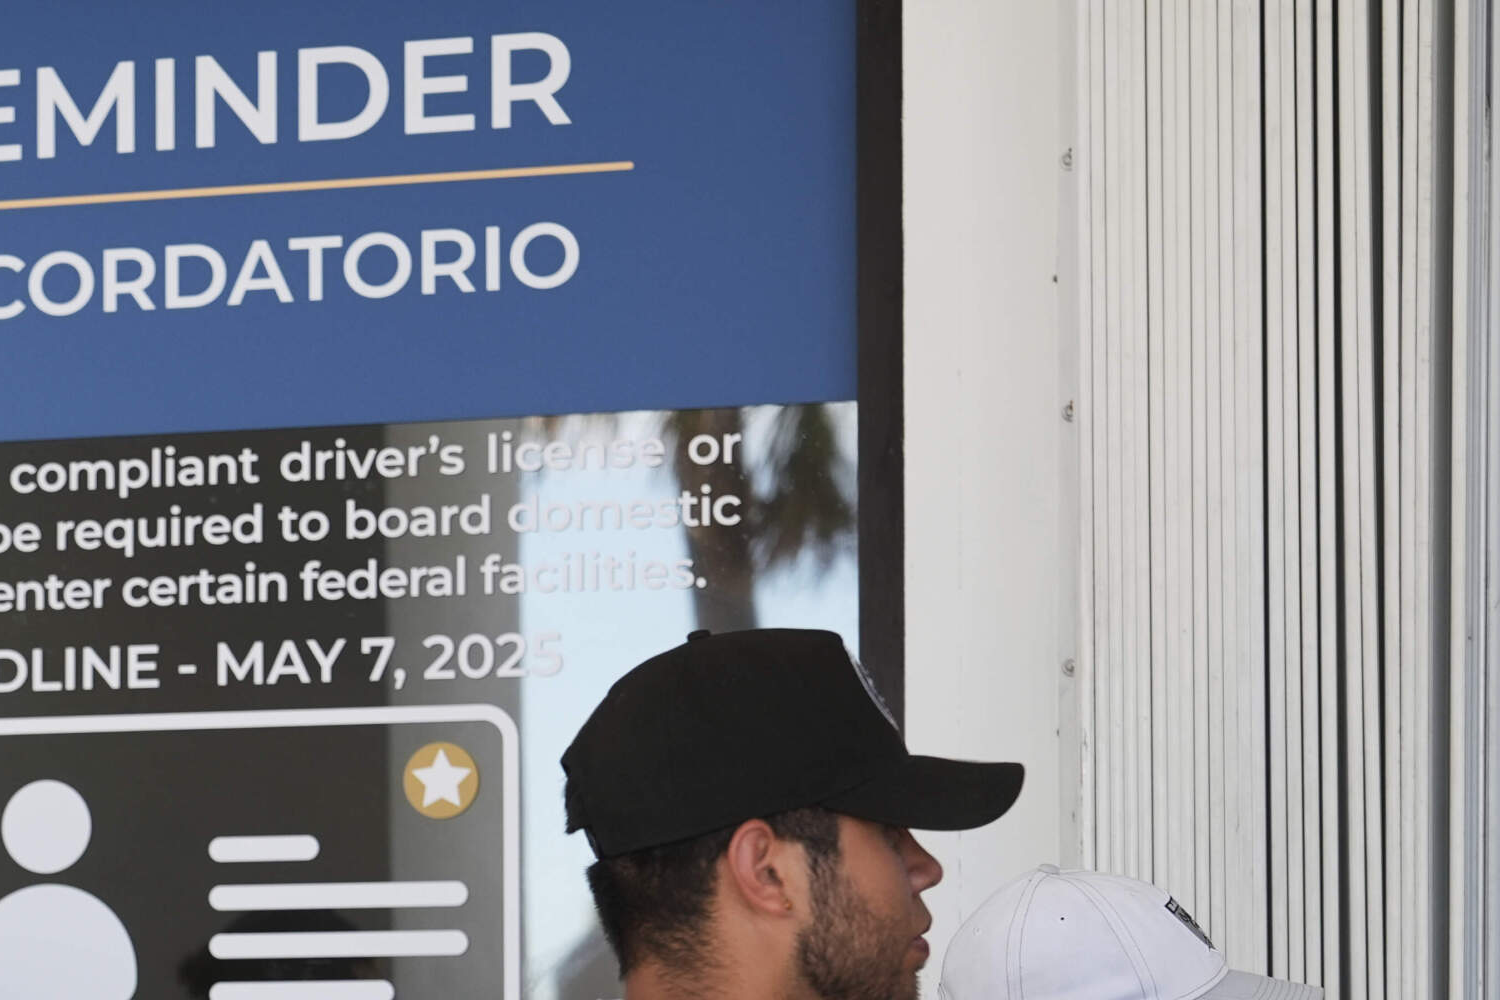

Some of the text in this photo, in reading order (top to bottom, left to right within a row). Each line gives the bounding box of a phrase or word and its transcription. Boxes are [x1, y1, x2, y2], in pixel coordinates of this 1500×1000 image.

[10, 445, 260, 499] compliant
[487, 431, 666, 475] license
[687, 432, 743, 466] or
[56, 503, 264, 558] required
[279, 507, 331, 542] to
[345, 493, 492, 541] board
[507, 484, 743, 534] domestic
[122, 561, 289, 608] certain
[300, 554, 466, 602] federal
[480, 549, 708, 596] facilities.
[216, 637, 346, 687] MAY
[361, 638, 407, 690] 7,
[422, 631, 564, 681] 2025
